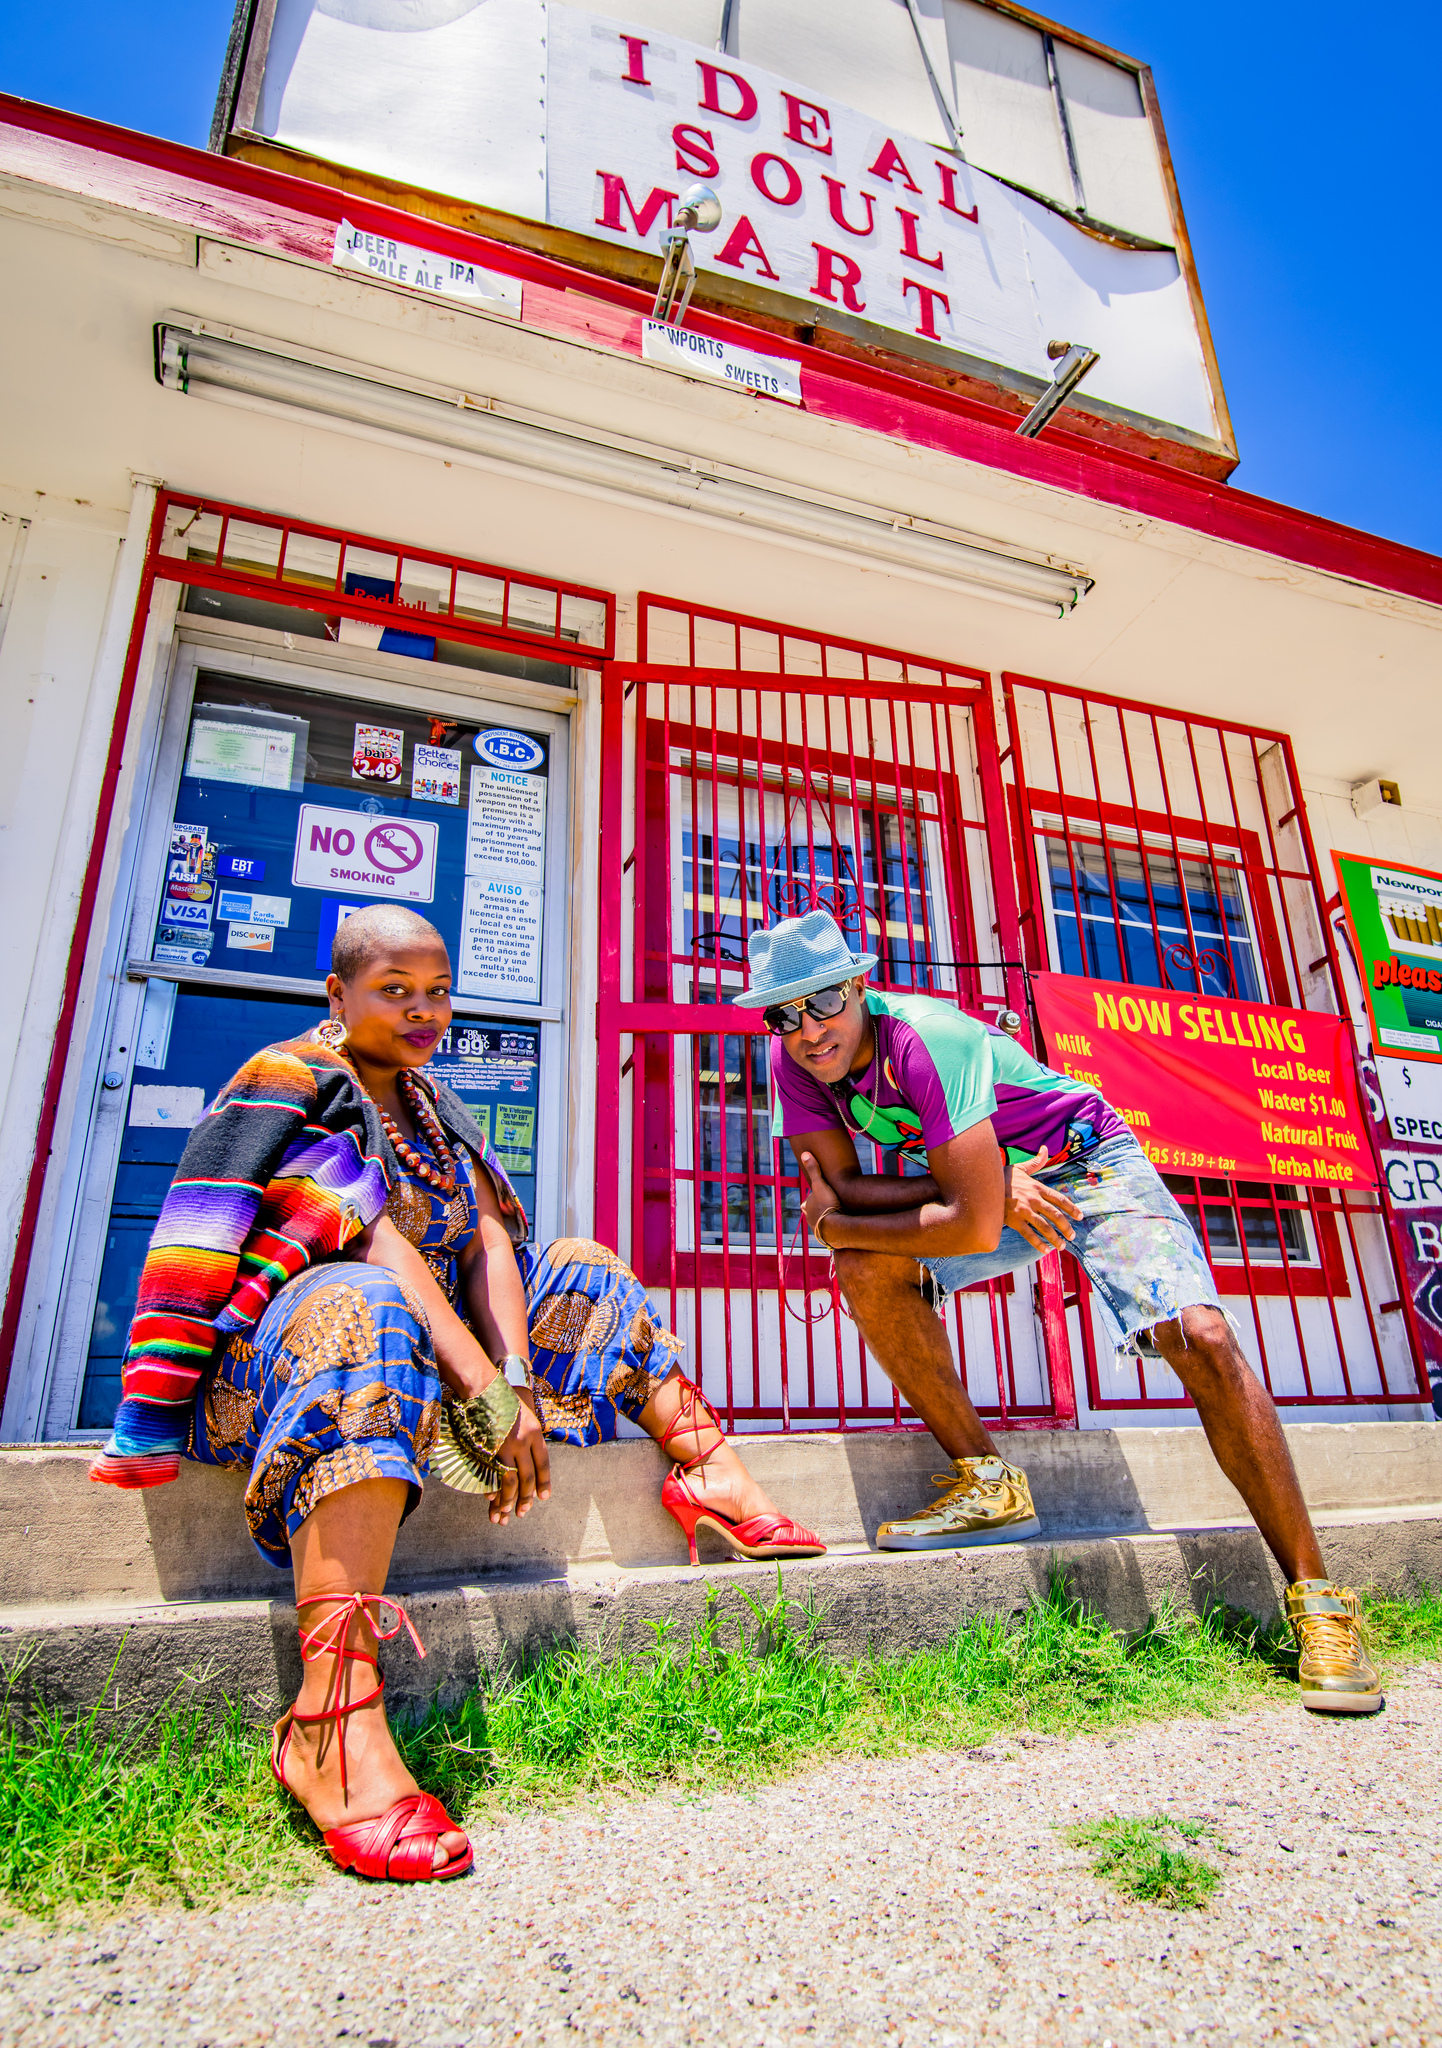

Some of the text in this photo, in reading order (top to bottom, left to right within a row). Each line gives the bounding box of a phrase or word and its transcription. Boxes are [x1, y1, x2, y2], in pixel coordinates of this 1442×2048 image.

[619, 33, 979, 223] IDEAL
[671, 123, 944, 271] SOUL
[354, 232, 474, 284] BEER IPA
[594, 170, 951, 341] MART
[368, 255, 443, 290] PALE ALE
[725, 364, 778, 393] SWEETS
[419, 748, 449, 760] Better
[489, 742, 530, 760] I.B.C.
[355, 759, 396, 779] $2.49
[418, 757, 459, 770] Choices
[491, 772, 528, 786] NOTICE
[479, 791, 521, 801] possession
[497, 786, 538, 796] unlicensed
[475, 798, 505, 807] weapon
[520, 804, 540, 813] these
[482, 807, 517, 816] premises
[483, 814, 506, 823] felony
[174, 824, 206, 832] UPGRADE
[473, 822, 541, 837] maximum penalty
[310, 825, 355, 856] NO
[471, 836, 525, 849] imprisonment
[232, 858, 254, 872] EBT
[474, 853, 537, 867] exceed $10,000.
[169, 872, 198, 882] PUSH
[330, 868, 395, 885] SMOKING
[170, 884, 210, 895] MasterCard
[488, 883, 522, 895] AVISO
[480, 894, 516, 904] Posesión
[169, 904, 207, 920] VISA
[470, 909, 503, 919] licencia
[484, 904, 509, 912] armas
[253, 917, 285, 925] Welcome
[480, 919, 500, 927] local
[231, 930, 270, 940] DISCOVER
[470, 927, 498, 936] crimen
[497, 940, 530, 948] máxima
[475, 954, 501, 962] cárcel
[481, 963, 504, 971] multa
[463, 970, 536, 983] exceder $10,000.
[1093, 992, 1306, 1054] NOW SELLING
[468, 1033, 488, 1041] ONLY
[1055, 1032, 1092, 1057] Milk
[1251, 1057, 1331, 1084] Local Beer
[1402, 1066, 1411, 1088] $
[1258, 1088, 1346, 1118] Water $1.00
[510, 1107, 532, 1115] Welcome
[1115, 1107, 1150, 1126] eam
[501, 1119, 529, 1127] Customers
[1261, 1122, 1359, 1151] Natural Fruit
[1173, 1150, 1204, 1167] $1.39
[1218, 1156, 1236, 1170] tax
[1266, 1153, 1353, 1181] Yerba Mate
